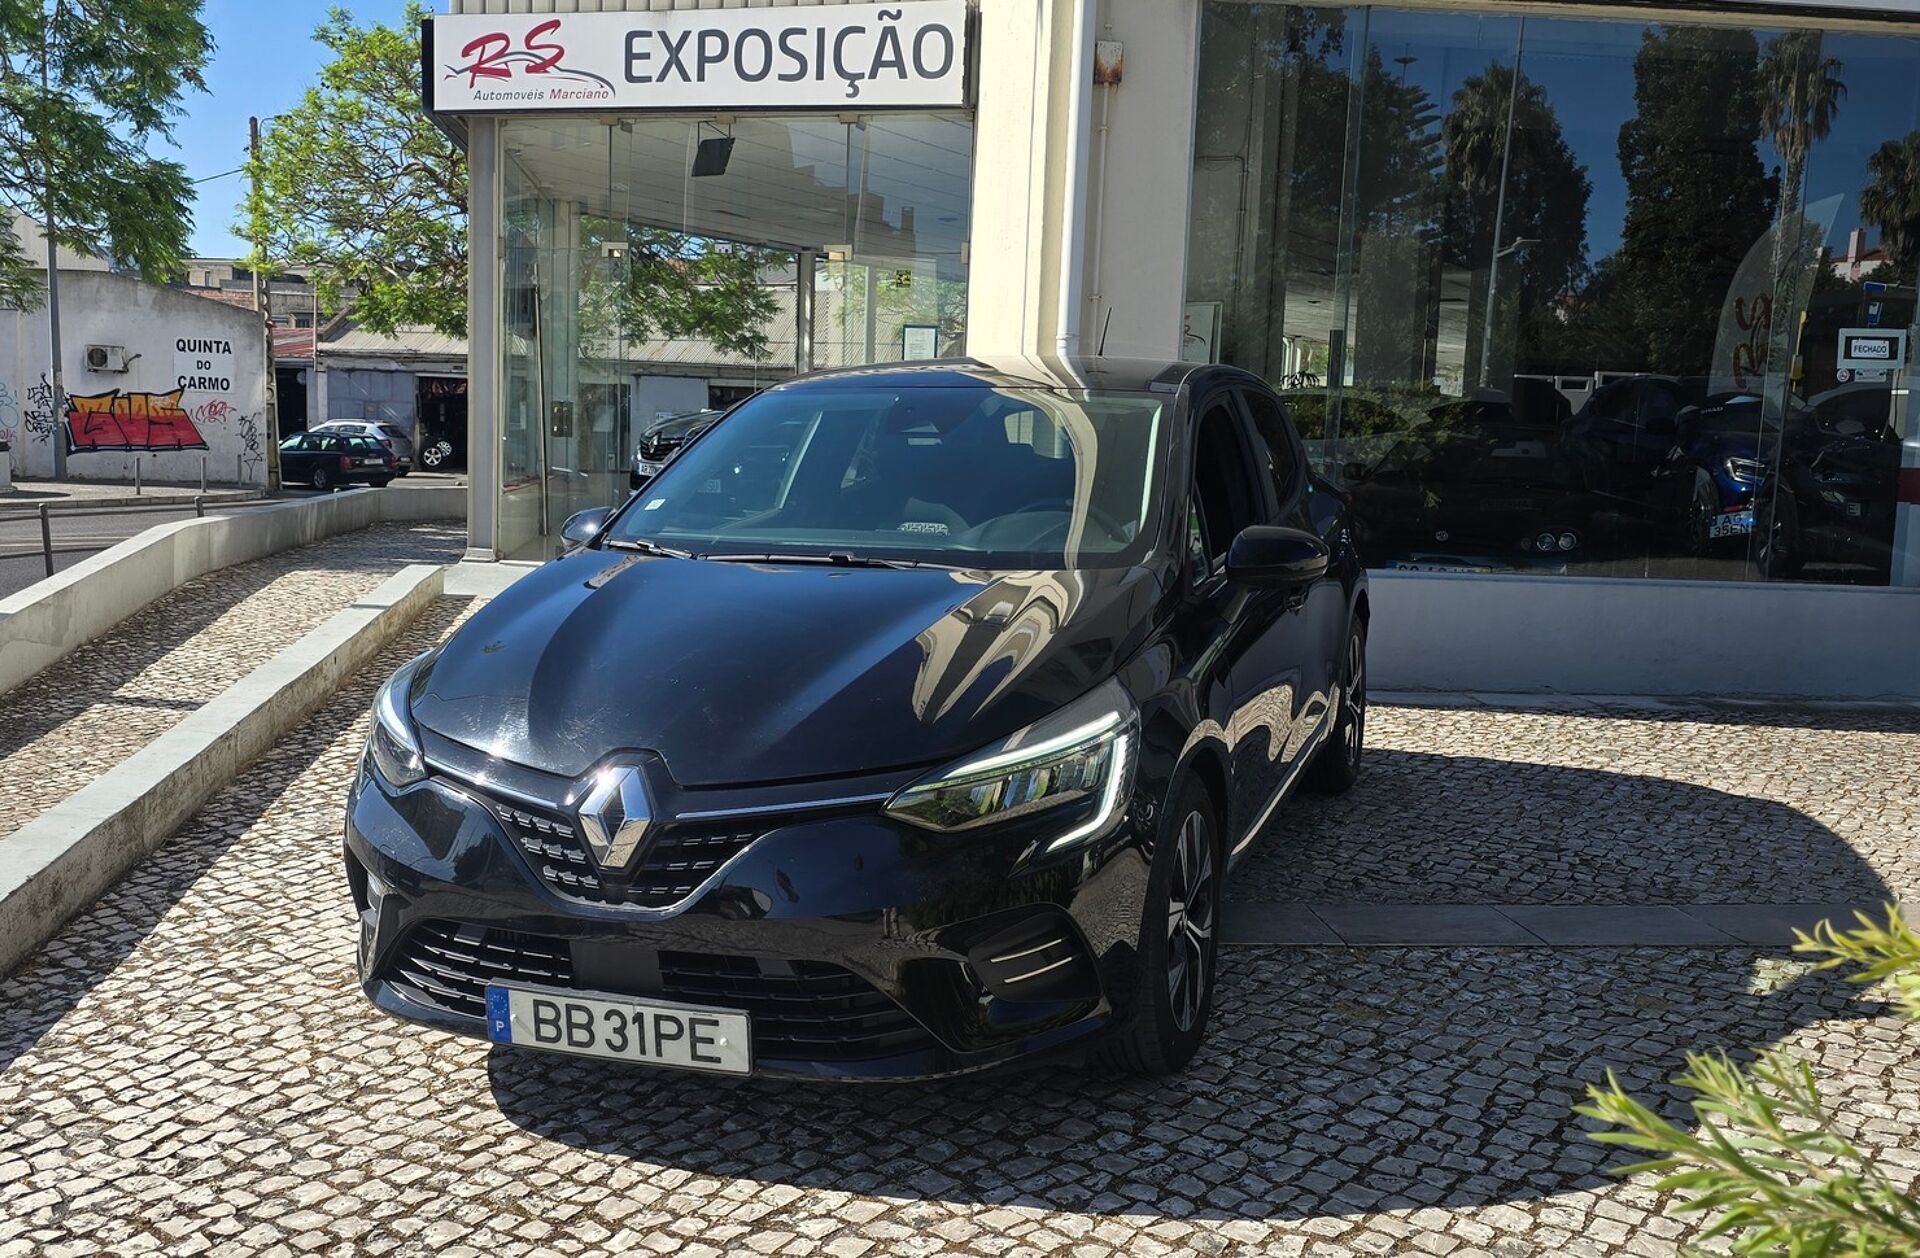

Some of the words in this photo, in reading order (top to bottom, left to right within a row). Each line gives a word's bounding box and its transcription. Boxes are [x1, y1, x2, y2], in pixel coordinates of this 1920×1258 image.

[461, 19, 565, 89] RS
[624, 9, 954, 98] EXPOSIÇÃO
[473, 88, 545, 101] Automovéis
[549, 88, 610, 100] Marciano
[176, 339, 232, 354] QUINTA
[1853, 345, 1887, 354] FECHADO
[196, 360, 211, 370] DO
[177, 375, 230, 391] CARMO
[495, 1020, 505, 1032] P
